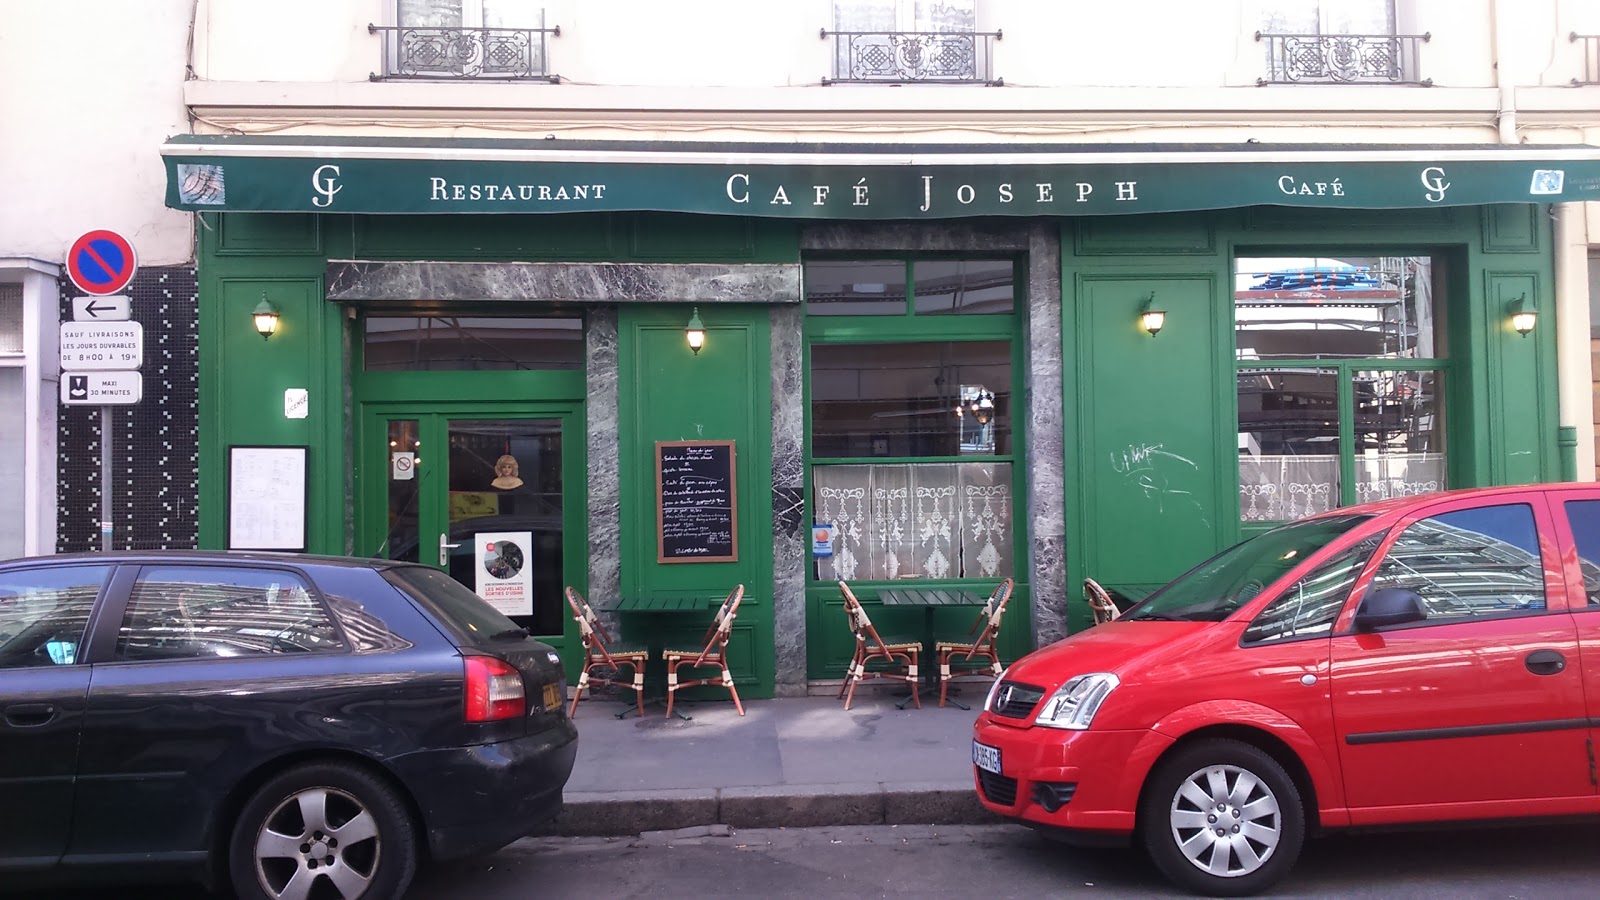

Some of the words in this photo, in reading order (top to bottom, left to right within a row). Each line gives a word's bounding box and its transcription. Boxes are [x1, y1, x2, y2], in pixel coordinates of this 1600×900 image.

[430, 177, 606, 201] RESTAURANT
[726, 173, 870, 206] CAFÉ
[920, 175, 1138, 212] JOSEPH
[1278, 175, 1345, 197] CAFÉ
